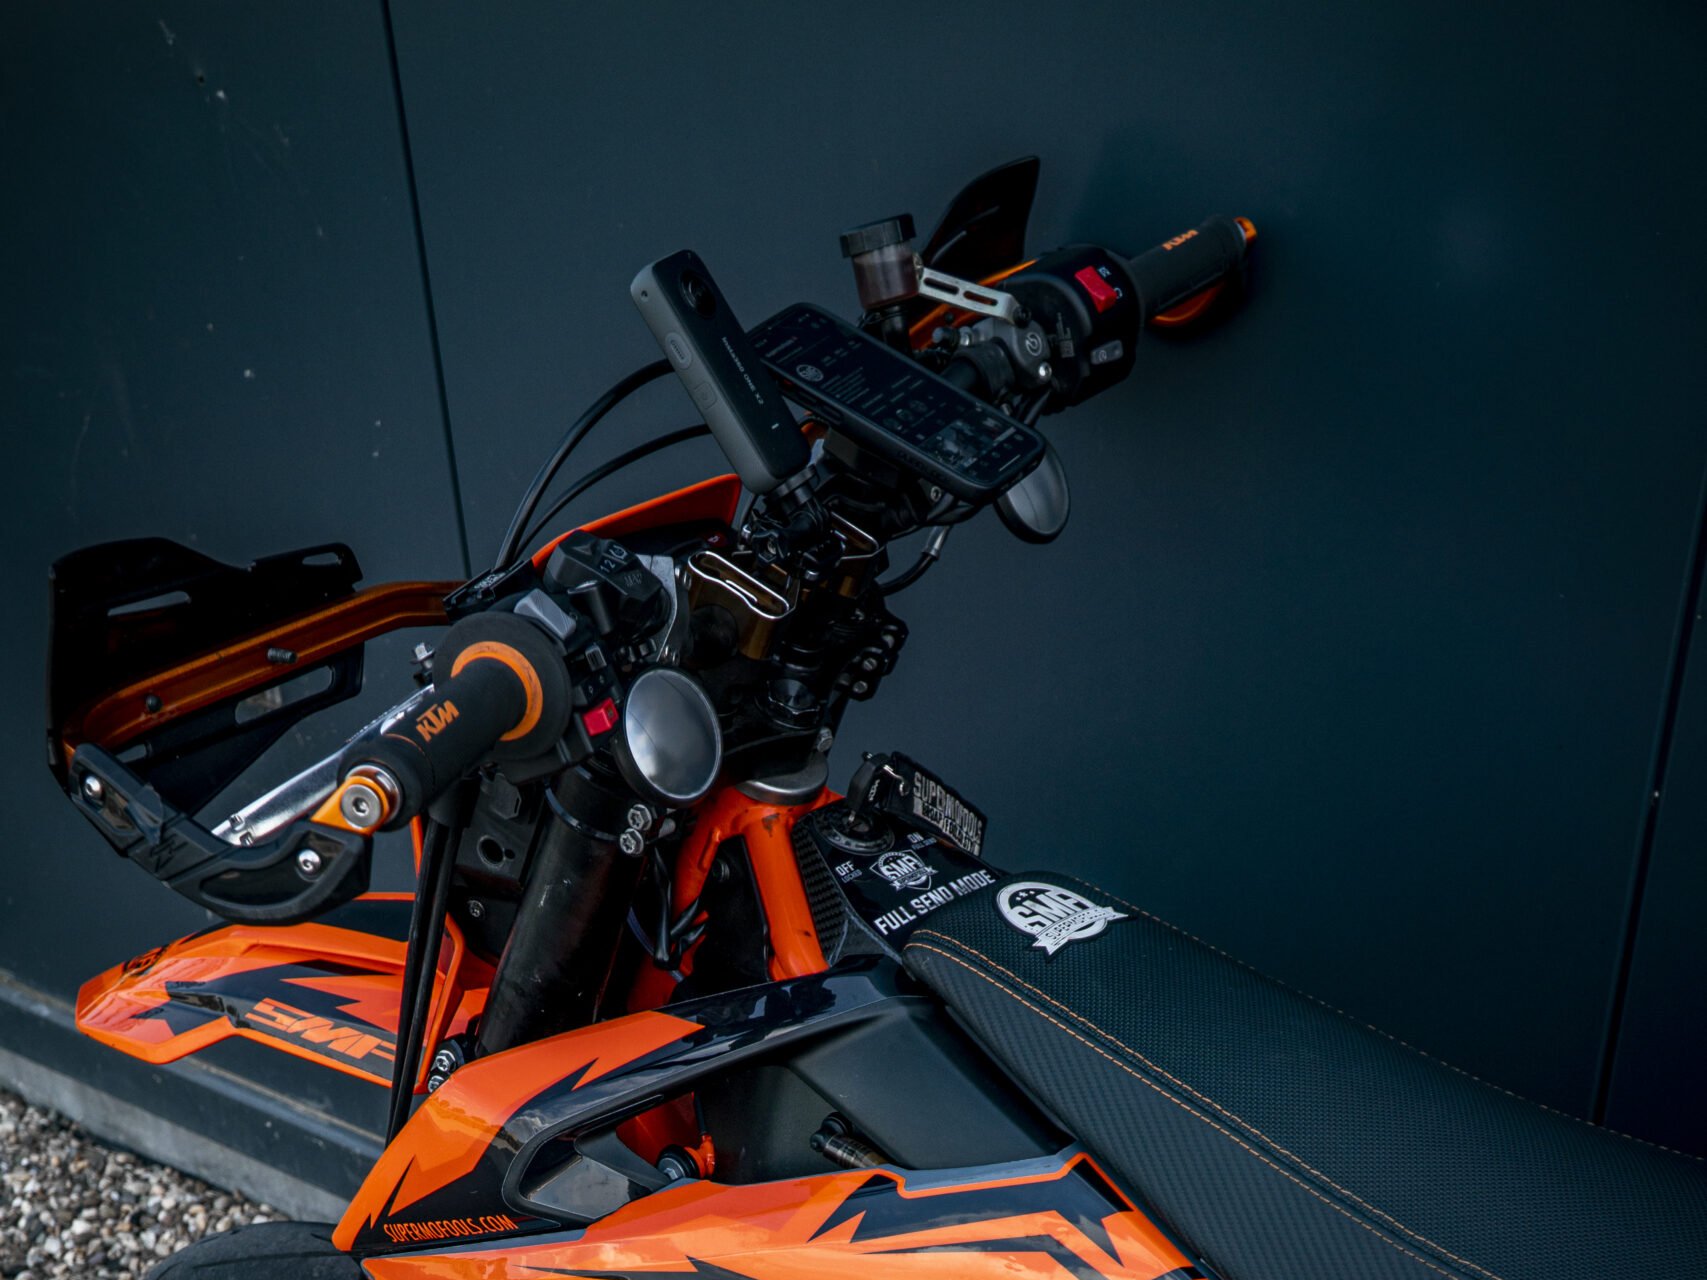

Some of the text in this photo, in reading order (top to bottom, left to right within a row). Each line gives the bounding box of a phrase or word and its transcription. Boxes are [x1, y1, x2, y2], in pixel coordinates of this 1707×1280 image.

[721, 336, 765, 405] Insta360 ONE X2
[416, 698, 461, 743] KTM
[906, 831, 925, 845] ON
[834, 859, 855, 877] OFF
[873, 905, 917, 936] FULL
[909, 885, 955, 917] SEND
[948, 868, 997, 897] MODE
[383, 1214, 519, 1244] SUPERMOFOOLS.COM
